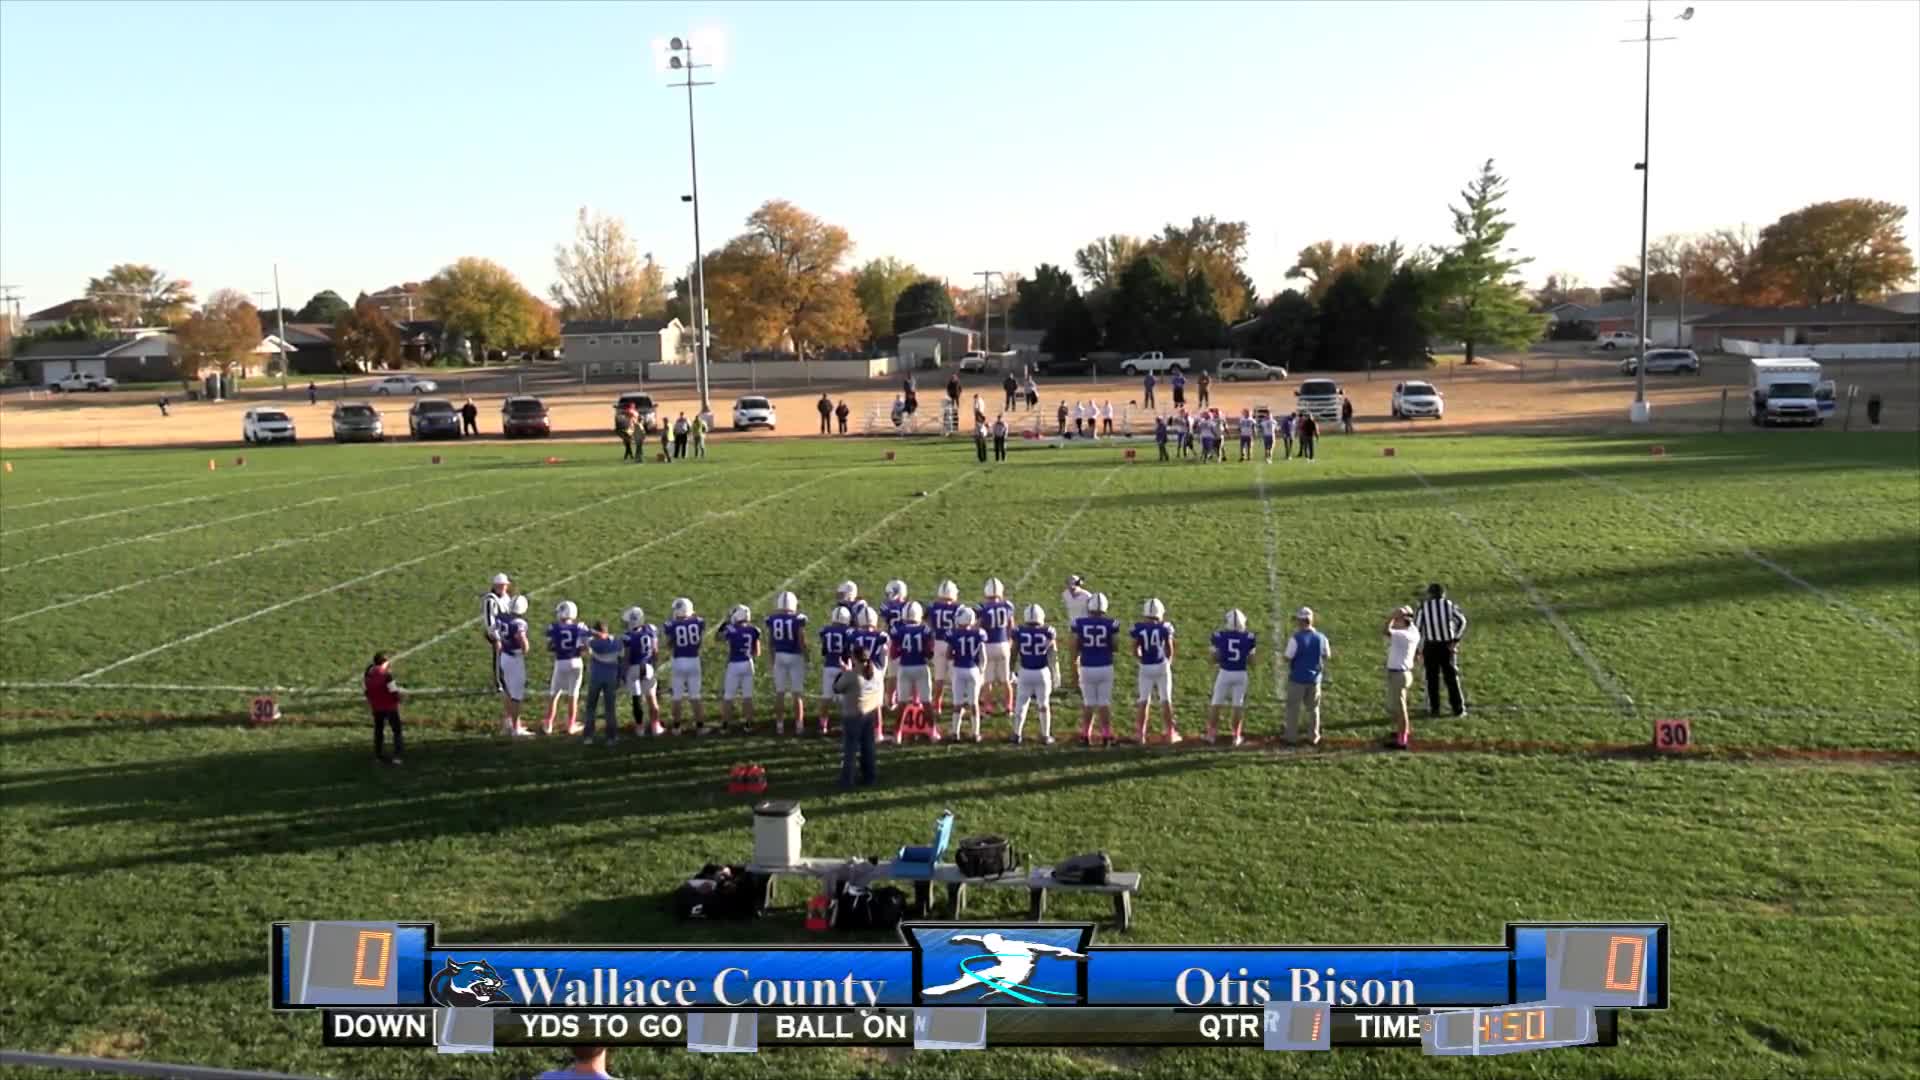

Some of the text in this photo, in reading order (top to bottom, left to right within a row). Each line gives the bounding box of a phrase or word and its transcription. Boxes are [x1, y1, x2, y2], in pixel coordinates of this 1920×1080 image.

[935, 609, 953, 630] 15
[987, 607, 1007, 629] 10
[560, 630, 573, 649] 2
[675, 623, 700, 647] 88
[772, 618, 794, 641] 81
[1082, 625, 1108, 648] 52
[824, 632, 844, 653] 13
[856, 635, 876, 655] 17
[902, 633, 923, 653] 41
[958, 636, 977, 656] 11
[1020, 633, 1047, 656] 22
[1139, 629, 1165, 653] 14
[1228, 639, 1241, 661] 5
[255, 699, 273, 719] 30
[903, 710, 926, 729] 40
[1661, 724, 1686, 746] 30
